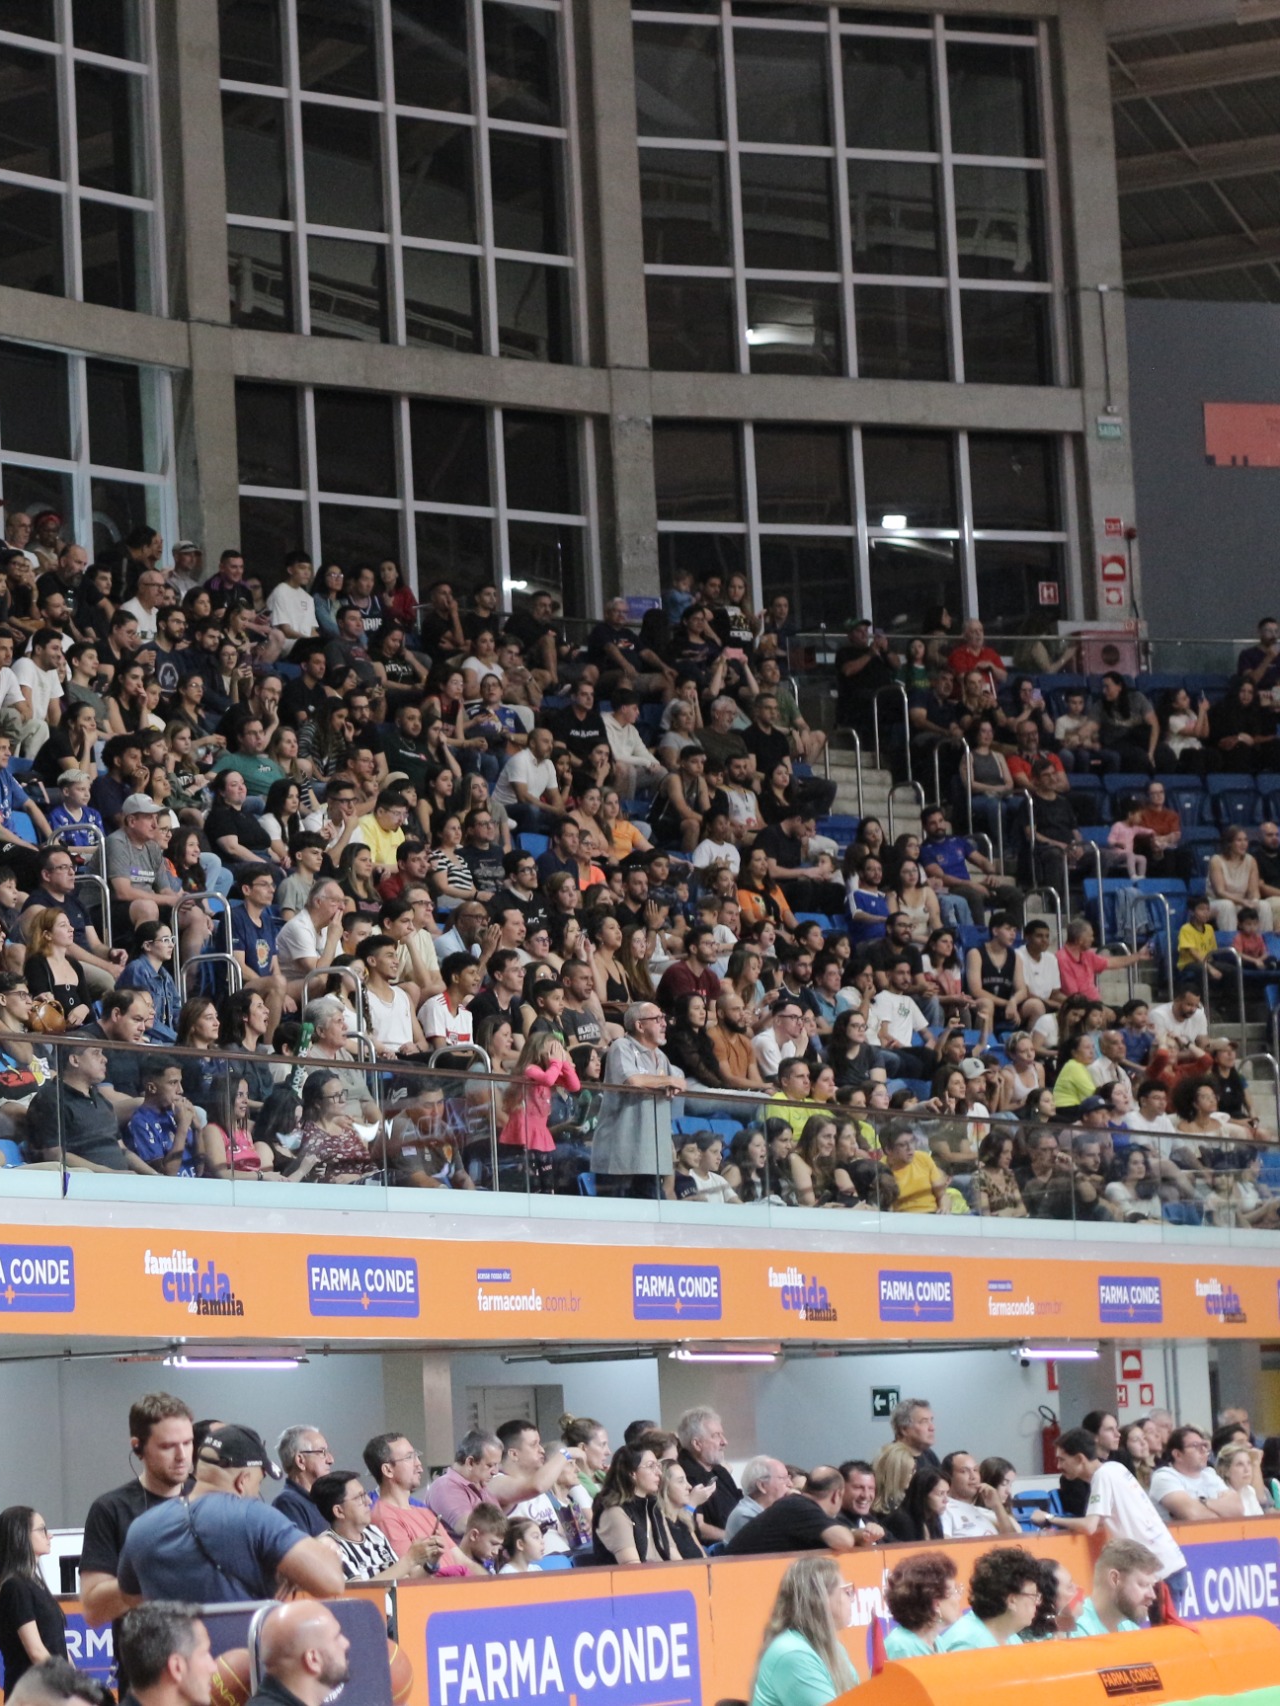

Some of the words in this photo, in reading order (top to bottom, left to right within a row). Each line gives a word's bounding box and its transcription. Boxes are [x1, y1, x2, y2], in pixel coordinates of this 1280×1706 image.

[10, 1257, 70, 1285] CONDE
[144, 1249, 196, 1274] família
[162, 1258, 231, 1303] cuida
[311, 1267, 362, 1291] FARMA
[365, 1268, 415, 1293] CONDE
[635, 1275, 676, 1297] FARMA
[678, 1276, 719, 1298] CONDE
[880, 1280, 915, 1301] FARMA
[916, 1281, 951, 1302] CONDE
[196, 1292, 244, 1316] família
[477, 1287, 581, 1312] farmaconde.com.br
[1100, 1285, 1129, 1304] FARMA
[1130, 1286, 1160, 1304] CONDE
[1204, 1562, 1279, 1614] CONDE
[438, 1636, 565, 1706] FARMA
[573, 1622, 691, 1690] CONDE
[1101, 1671, 1131, 1688] FARMA
[1129, 1666, 1159, 1684] CONDE
